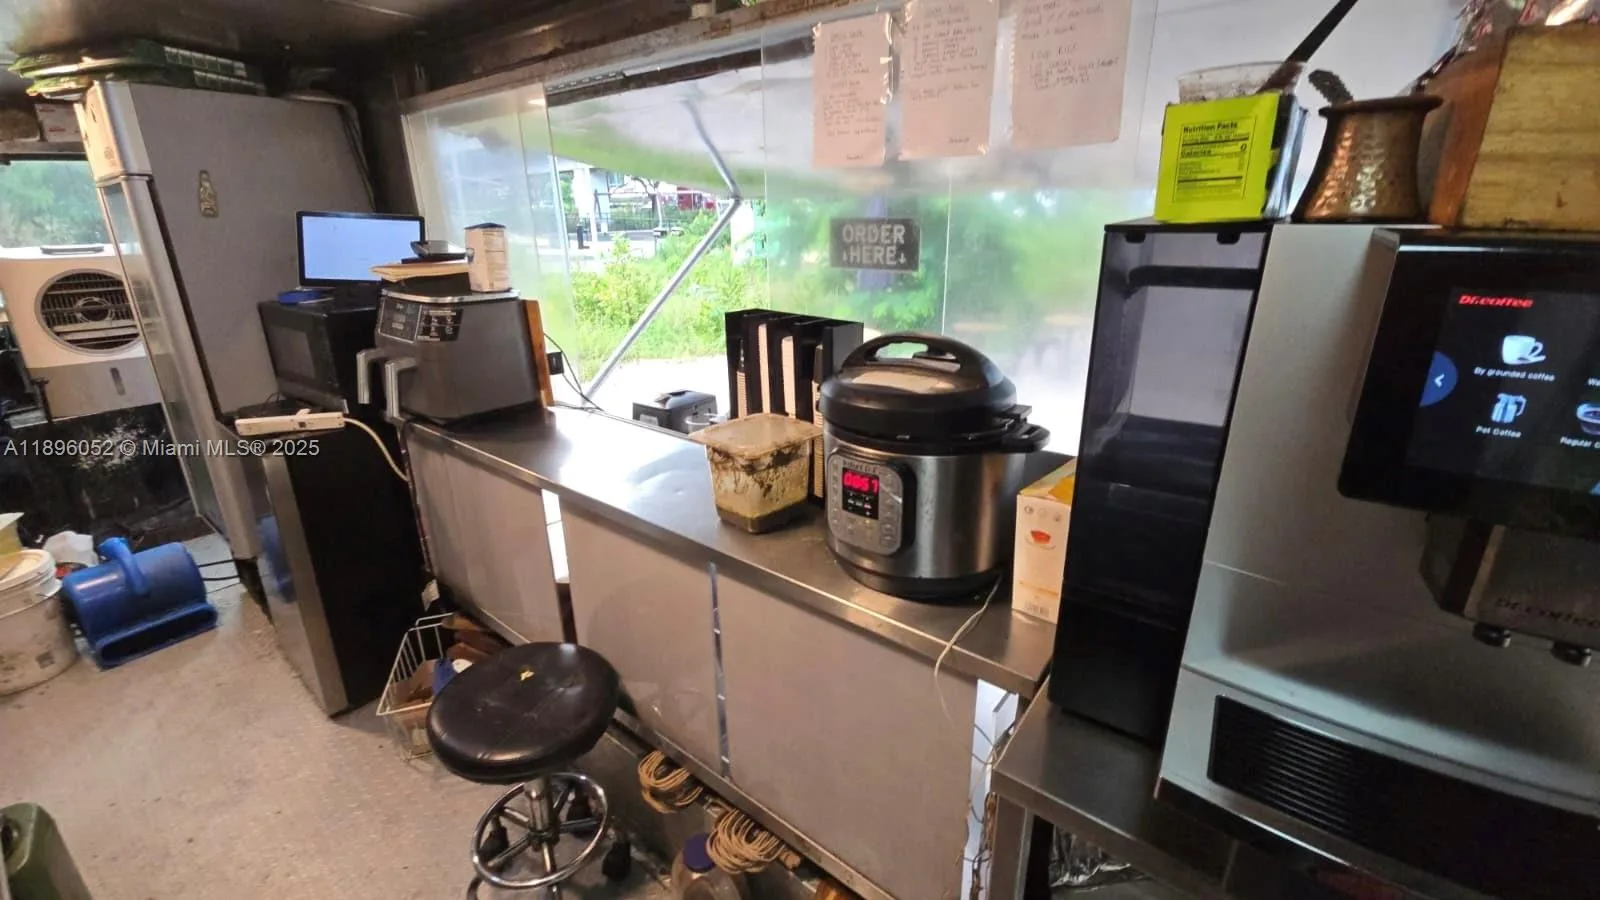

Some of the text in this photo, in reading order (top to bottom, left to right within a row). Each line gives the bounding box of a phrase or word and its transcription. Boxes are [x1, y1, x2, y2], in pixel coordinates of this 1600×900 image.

[1183, 121, 1238, 133] Nutrition Facts
[1181, 149, 1212, 158] Calories
[842, 223, 906, 245] ORDER
[850, 245, 897, 266] HERE
[1458, 294, 1534, 308] Dr.coffee
[1473, 366, 1555, 382] By grounded coffee
[1475, 425, 1522, 439] Pot Coffee
[1560, 436, 1592, 448] Regular
